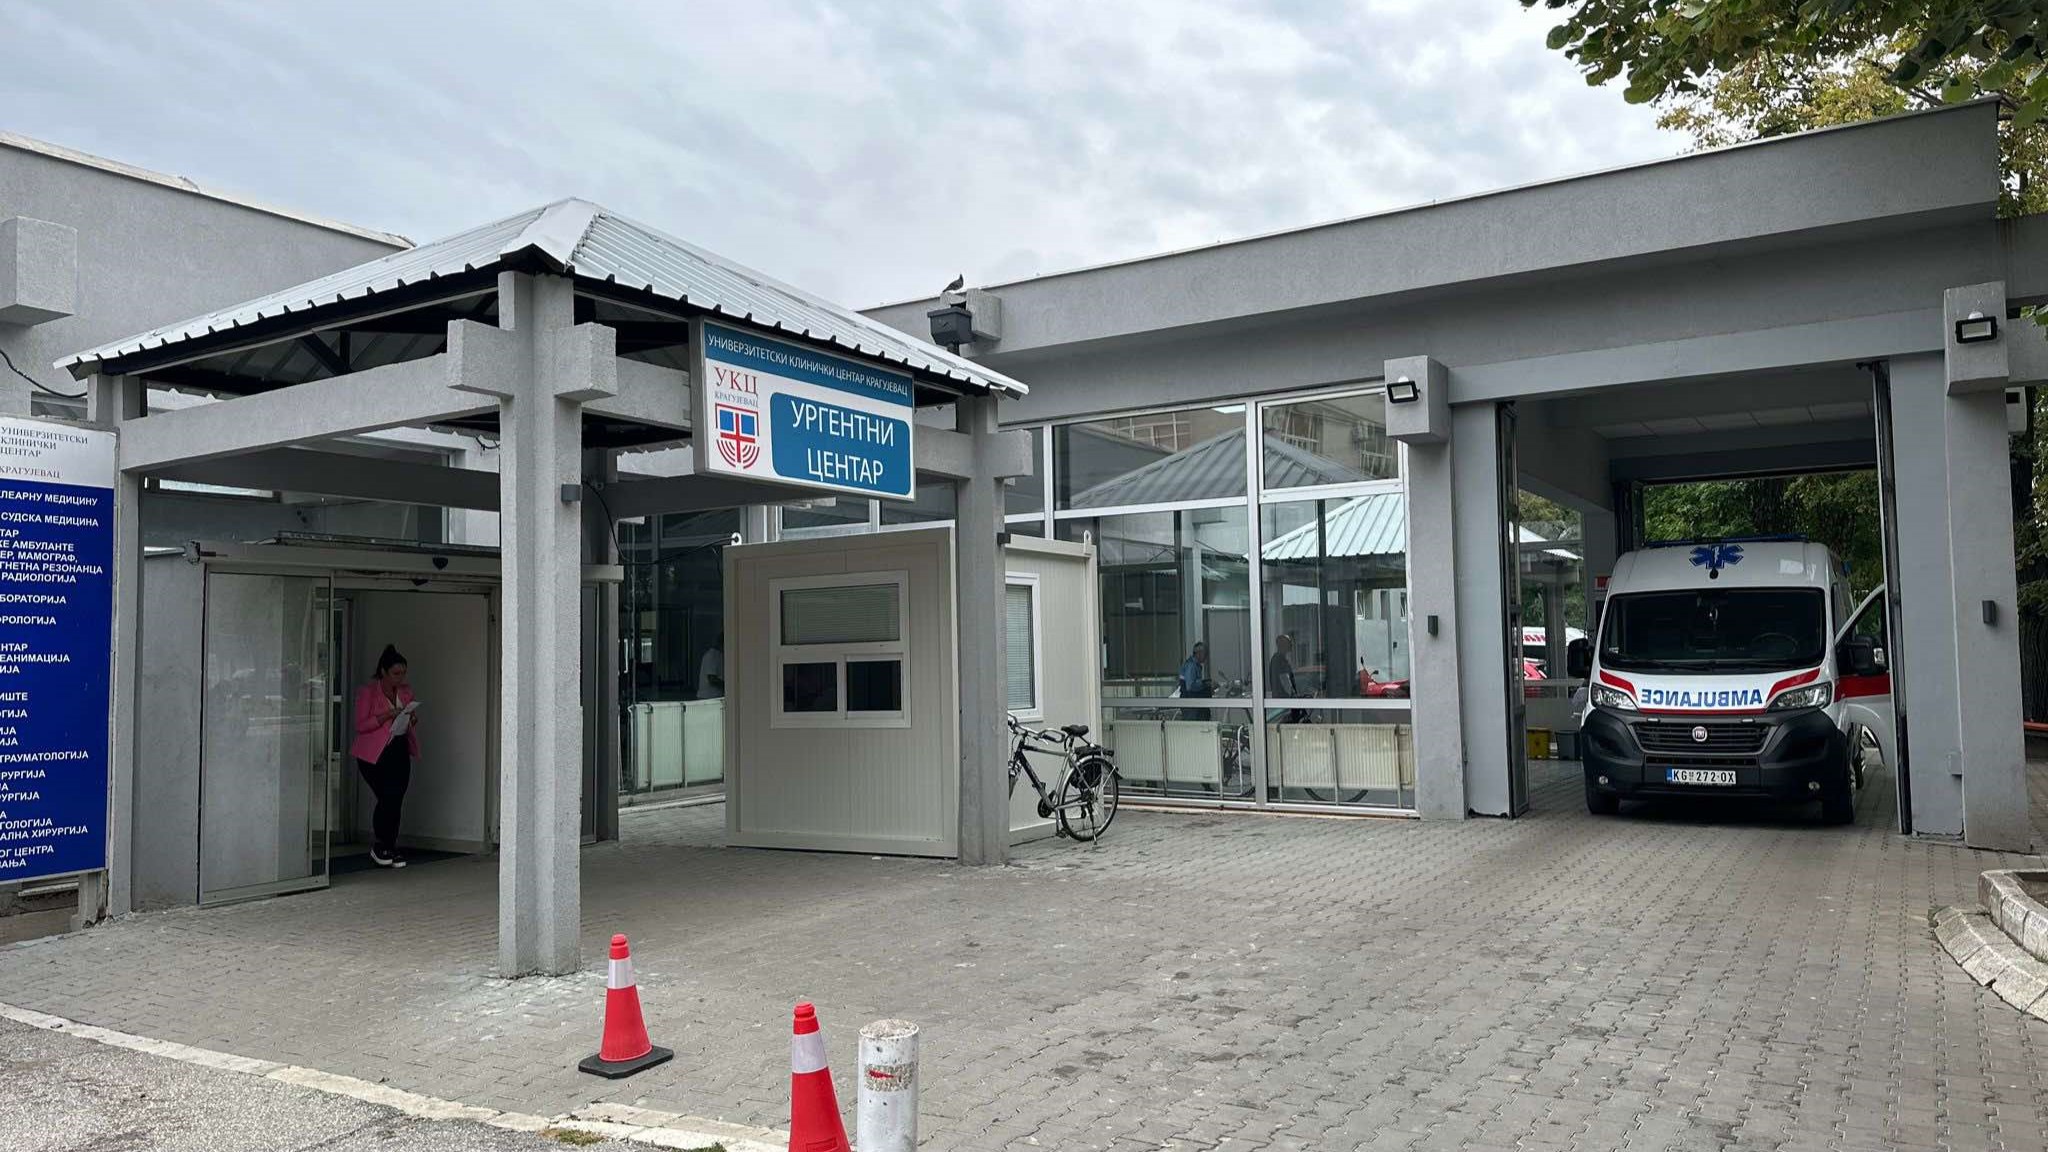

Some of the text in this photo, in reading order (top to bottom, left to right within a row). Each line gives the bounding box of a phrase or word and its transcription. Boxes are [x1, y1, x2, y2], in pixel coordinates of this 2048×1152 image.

[707, 333, 908, 398] УНИВЕРЗИТЕТСКИ КЛИНИЧКИ ЦЕНТАР КРАГУЈЕВАЦ
[714, 367, 758, 398] УКЦ
[714, 391, 758, 407] КРАГУЈЕВАЦ
[791, 400, 894, 447] УРГЕНТНИ
[1, 427, 88, 444] УНИВЕРЗИТЕТСКИ
[1, 437, 57, 450] КЛИНИЧКИ
[0, 447, 41, 457] ЦЕНТАР
[807, 448, 883, 485] ЦЕНТАР
[0, 490, 98, 506] ЛЕАРНУ МЕДИЦИНУ
[1, 511, 99, 527] СУДСКА МЕДИЦИНА
[0, 528, 19, 538] ТАР
[12, 540, 75, 552] АМБУЛАНТЕ
[17, 551, 78, 563] МАМОГРАФ,
[42, 563, 103, 574] РЕЗОНАНЦА
[1, 573, 76, 584] РАДИОЛОГИЈА
[0, 594, 67, 604] БОРАТОРИЈА
[0, 615, 57, 625] РОЛОГИЈА
[1, 643, 28, 652] НТАР
[0, 654, 70, 664] ЕАНИМАЦИЈА
[0, 709, 28, 718] ГИЈА
[1673, 769, 1687, 781] KG
[0, 791, 40, 803] УРГИЈА
[0, 825, 88, 841] АЛНА ХИРУРГИЈА
[14, 845, 54, 857] ЦЕНТРА
[0, 858, 26, 869] АЊА
